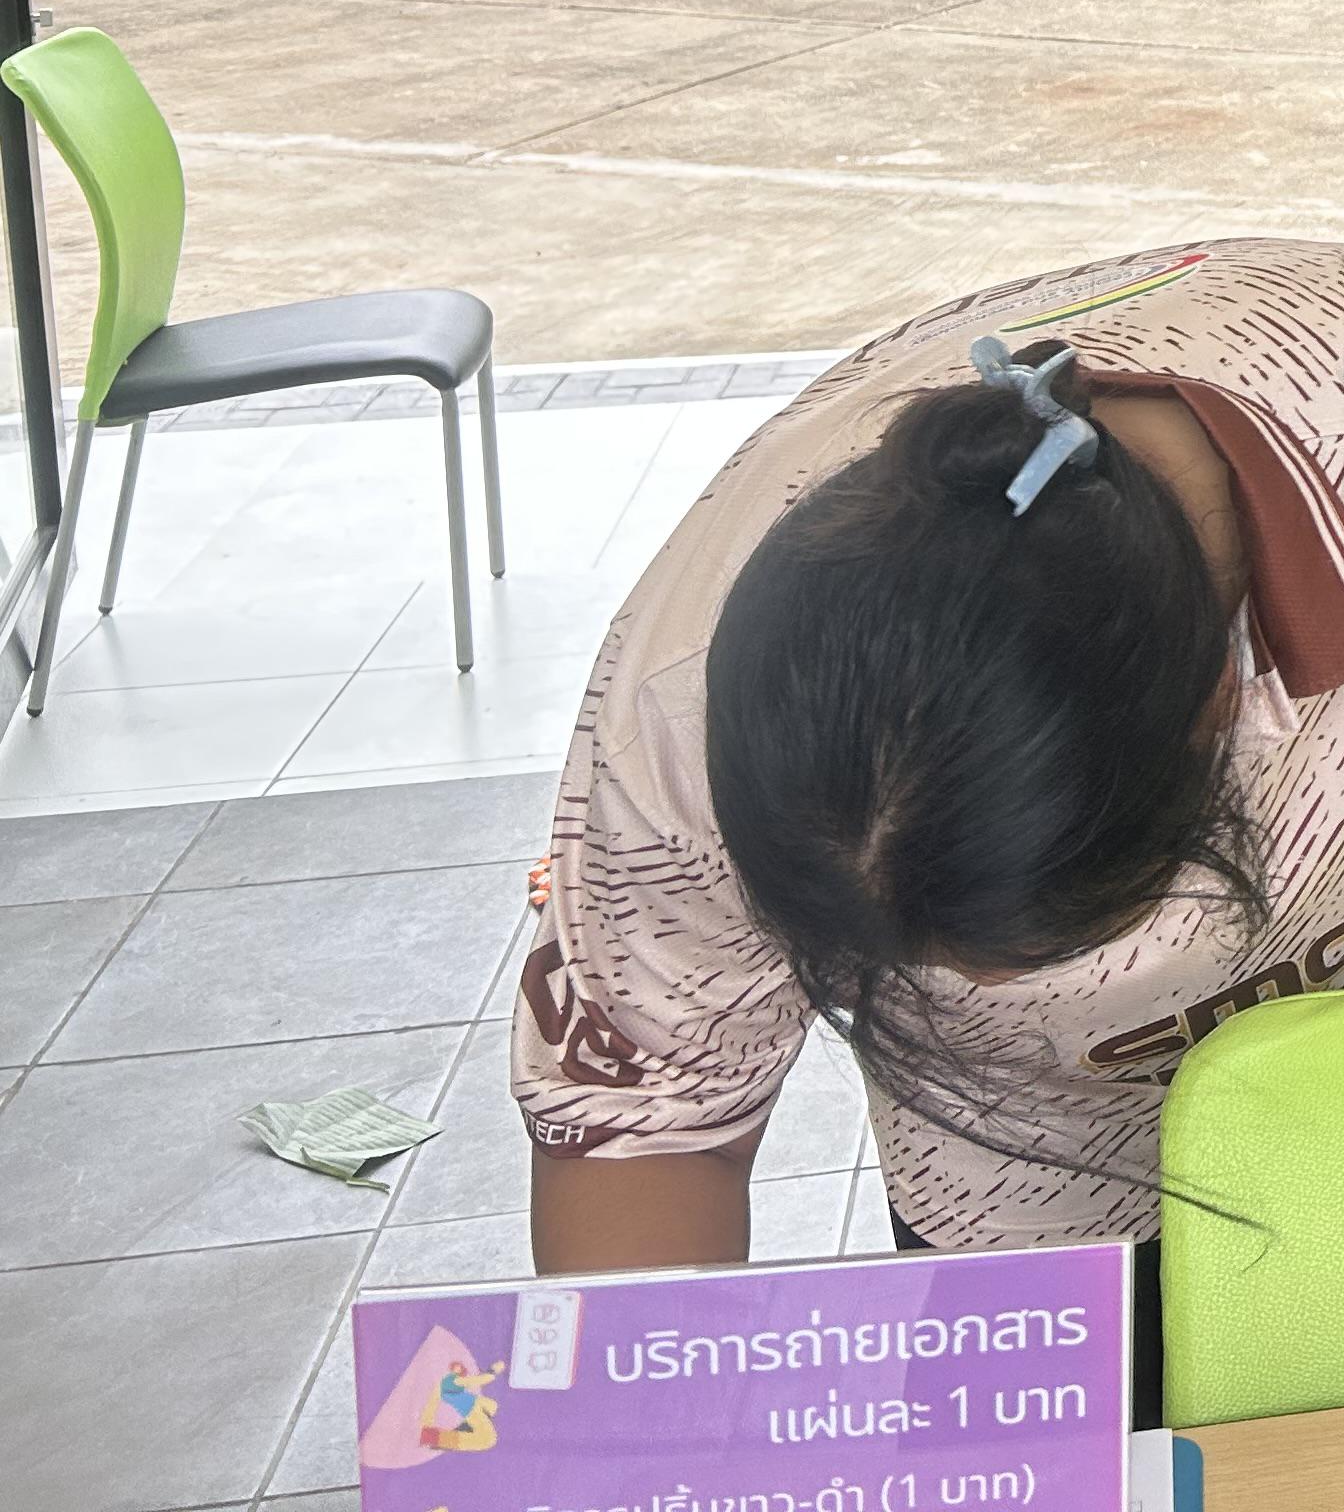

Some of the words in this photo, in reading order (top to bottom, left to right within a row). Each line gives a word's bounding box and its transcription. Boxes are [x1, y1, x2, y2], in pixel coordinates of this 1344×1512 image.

[606, 1306, 1089, 1383] บริการถ่ายเอกสาร
[769, 1387, 932, 1444] แผ่นละ
[948, 1384, 968, 1429] 1
[994, 1383, 1087, 1426] บาท
[940, 1462, 1036, 1506] บาท)
